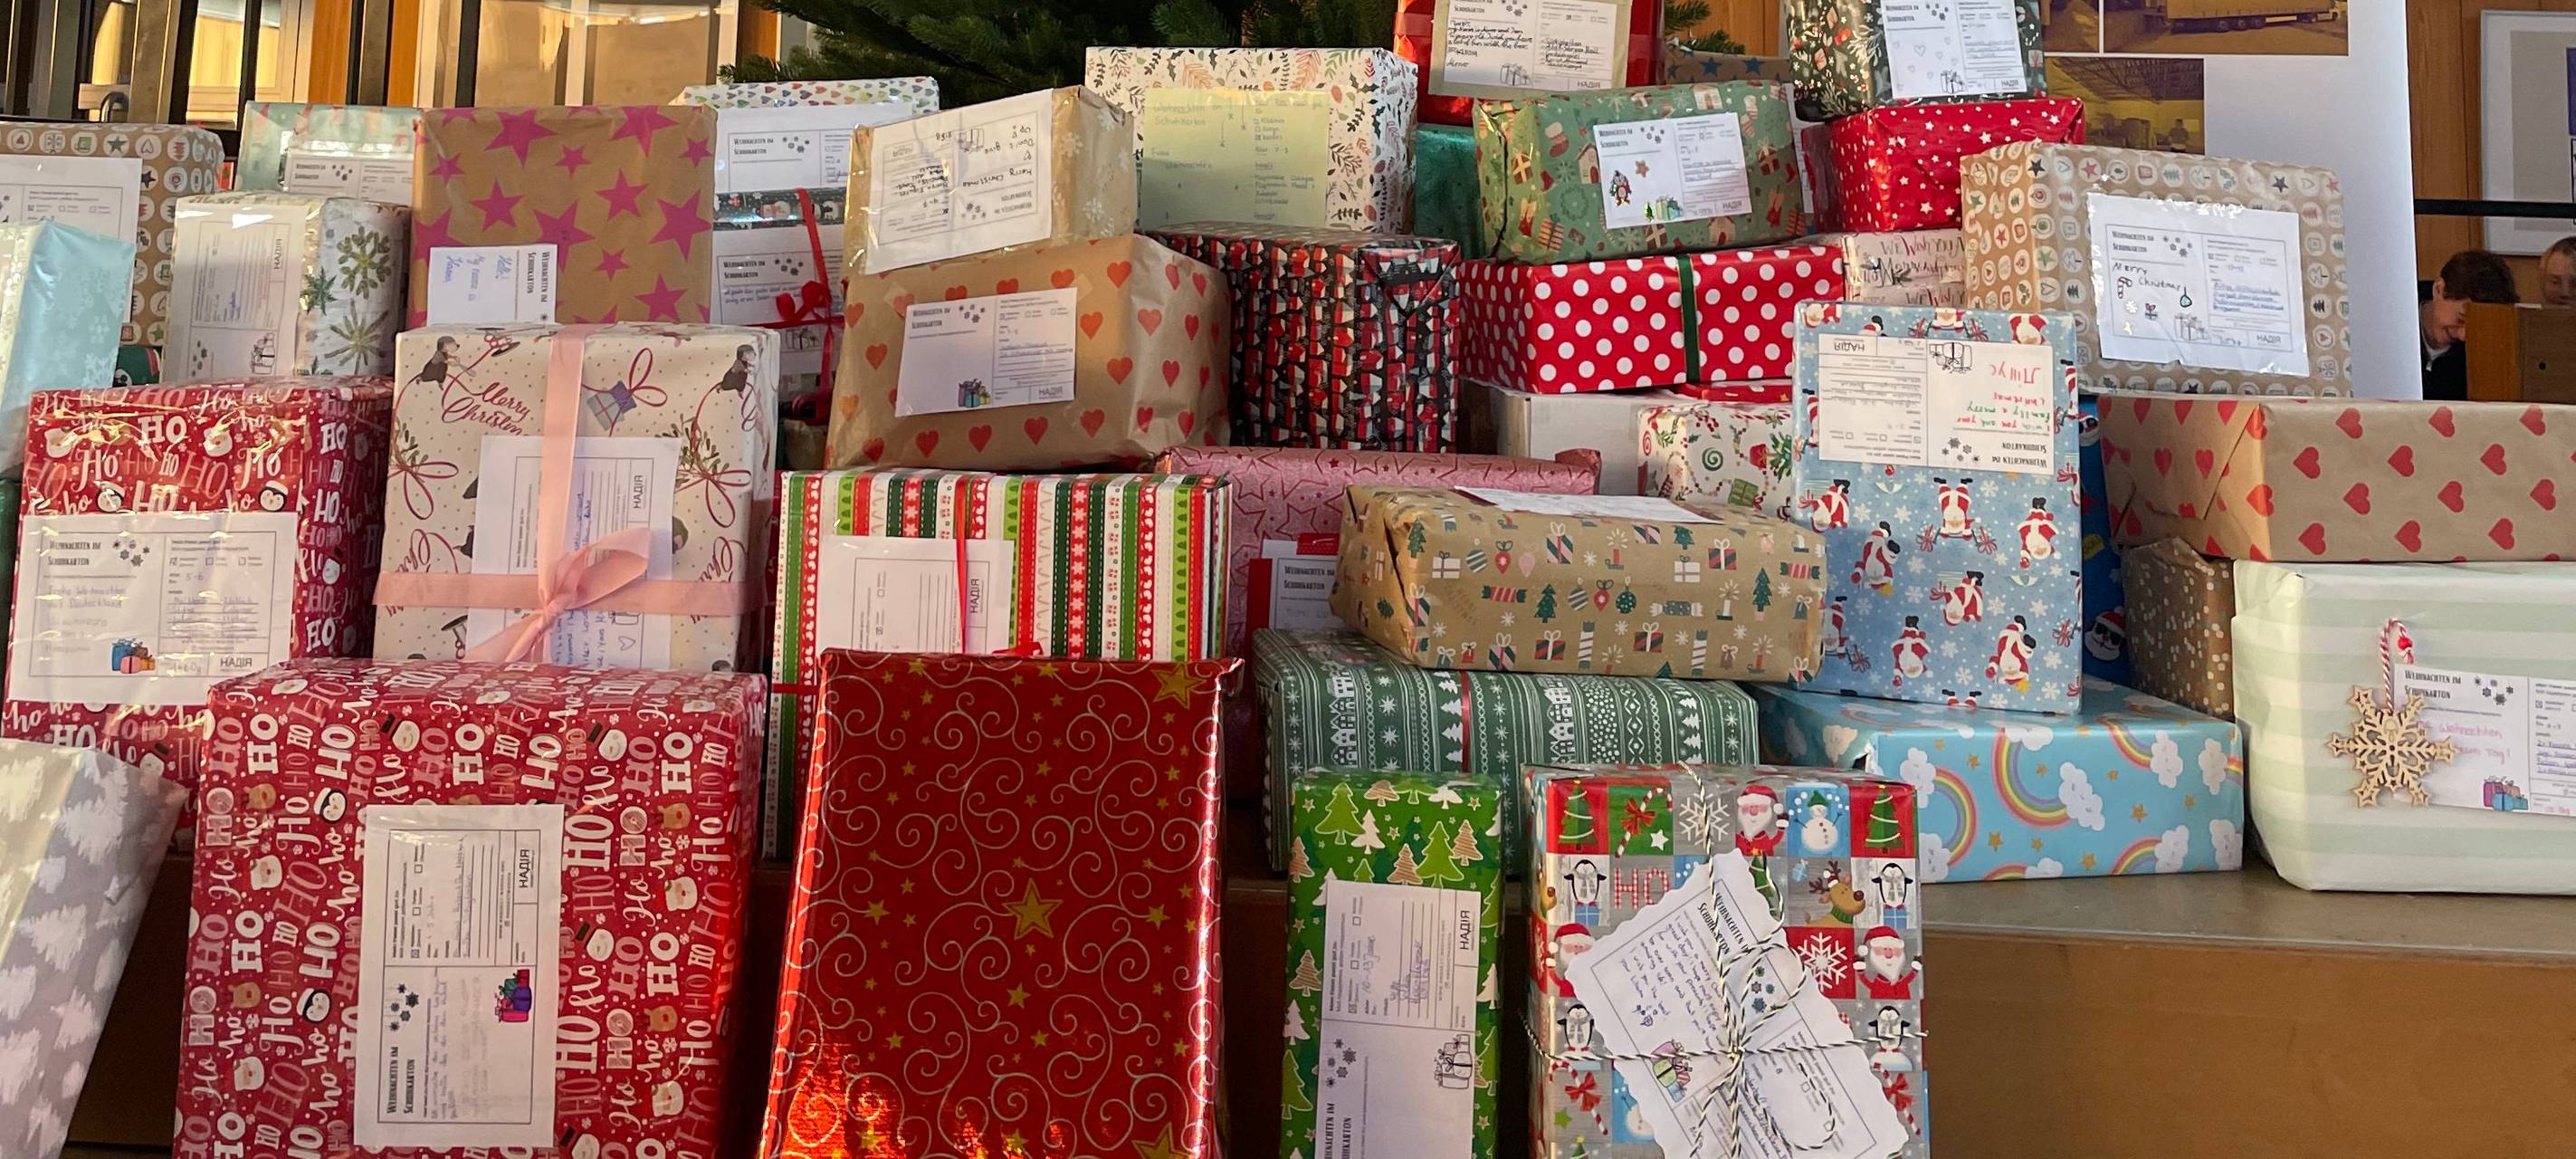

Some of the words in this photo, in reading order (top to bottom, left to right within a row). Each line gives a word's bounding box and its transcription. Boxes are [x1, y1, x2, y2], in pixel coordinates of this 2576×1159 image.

[138, 416, 187, 445] HO
[320, 423, 348, 454] HO
[159, 453, 179, 476] HO
[180, 452, 229, 498] HO
[314, 490, 339, 523] HO
[969, 578, 980, 614] НАДІЯ
[219, 656, 253, 668] НАДІЯ
[306, 620, 336, 653] HO
[247, 714, 279, 775] HO
[286, 724, 314, 750] HO
[315, 724, 357, 780] HO
[413, 727, 453, 789] HO
[453, 723, 486, 786] HO
[492, 733, 521, 759] HO
[521, 733, 562, 790] HO
[661, 732, 694, 794] HO
[701, 742, 729, 767] HO
[348, 755, 378, 799] HO
[622, 736, 657, 797] HO
[205, 787, 234, 847] HO
[274, 796, 323, 855] Ho
[562, 815, 615, 872] HO
[619, 806, 648, 867] HO
[519, 848, 530, 889] НАДІЯ
[1614, 867, 1671, 910] HO
[192, 914, 229, 976] HO
[230, 910, 263, 973] HO
[272, 920, 300, 948] HO
[299, 922, 342, 979] HO
[688, 943, 716, 970] HO
[1460, 909, 1471, 951] НАДІЯ
[646, 932, 680, 996] HO
[188, 985, 217, 1046] HO
[259, 996, 305, 1056] Ho
[606, 1008, 634, 1069] HO
[557, 1015, 601, 1074] HO
[254, 1124, 281, 1150] HO
